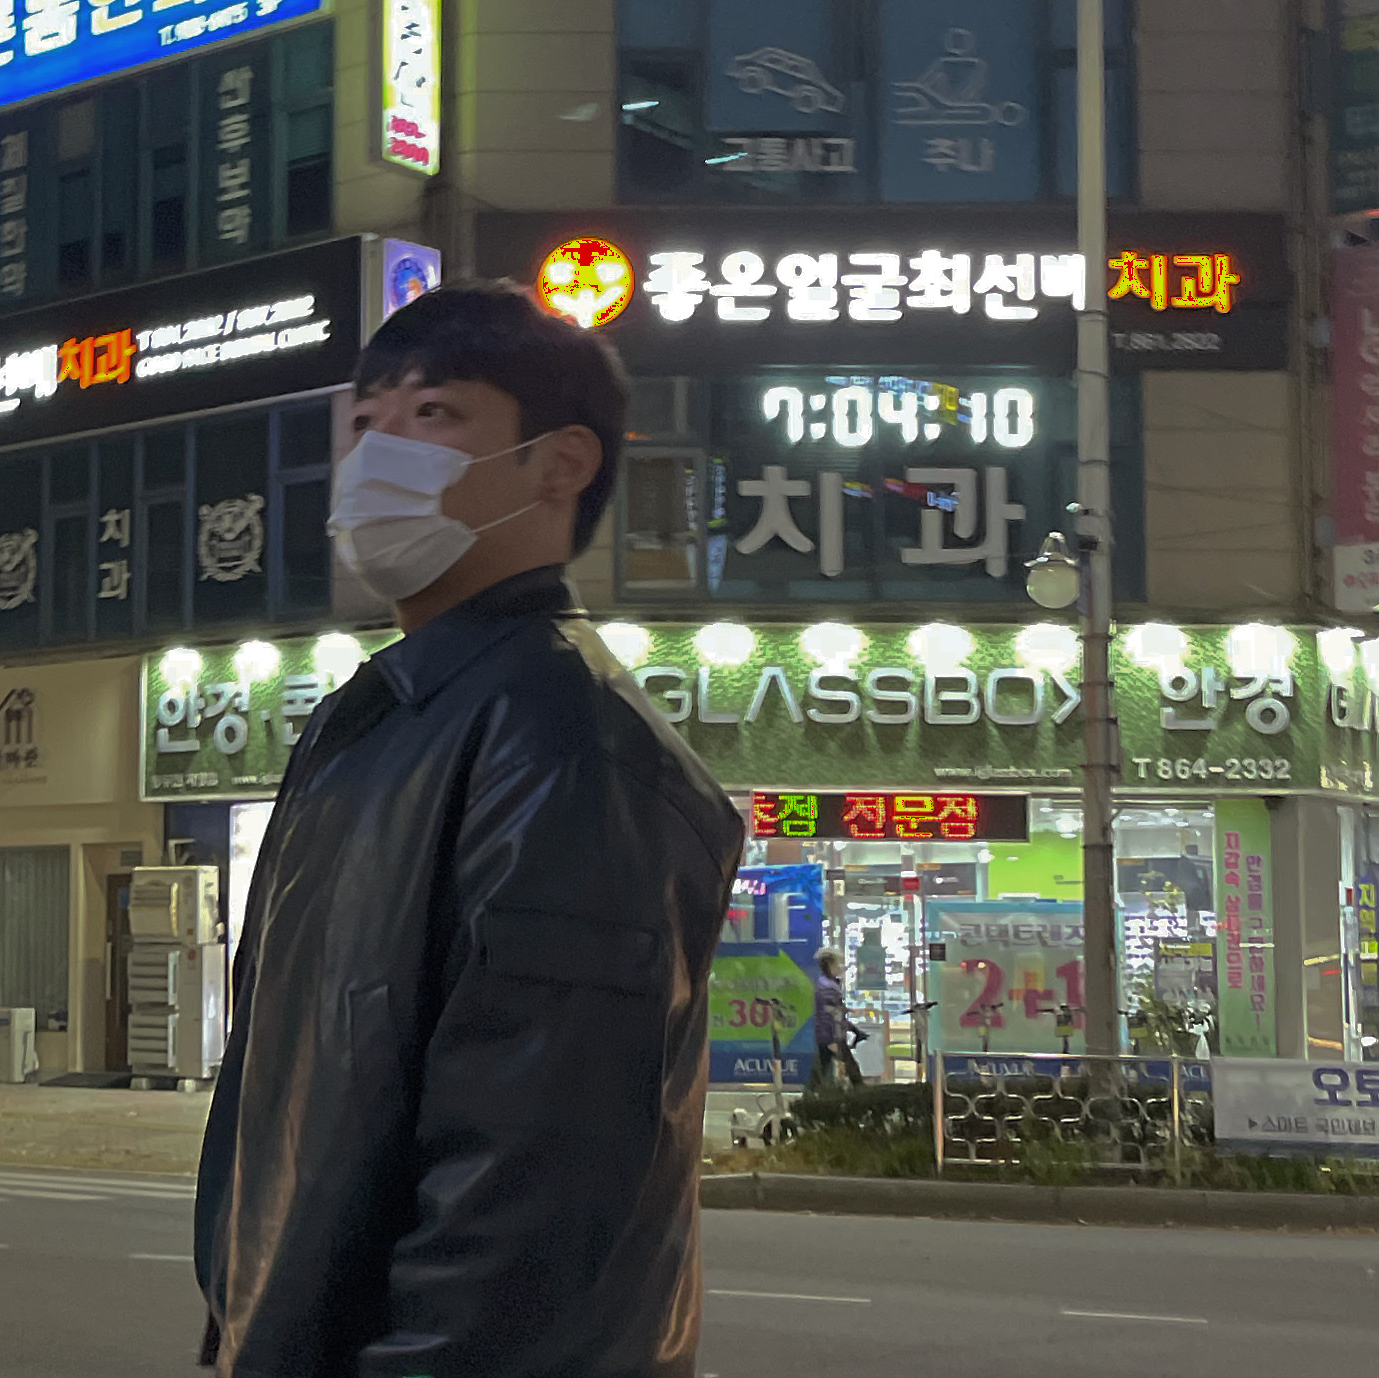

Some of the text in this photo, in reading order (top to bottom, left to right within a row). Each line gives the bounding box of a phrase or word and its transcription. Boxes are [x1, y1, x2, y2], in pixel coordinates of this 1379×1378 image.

[721, 137, 858, 172] 교통사고
[735, 465, 1025, 578] 치과
[98, 508, 130, 600] 치과
[1159, 665, 1293, 735] 안경
[841, 795, 978, 839] 전문점
[1262, 1116, 1308, 1134] 스마트
